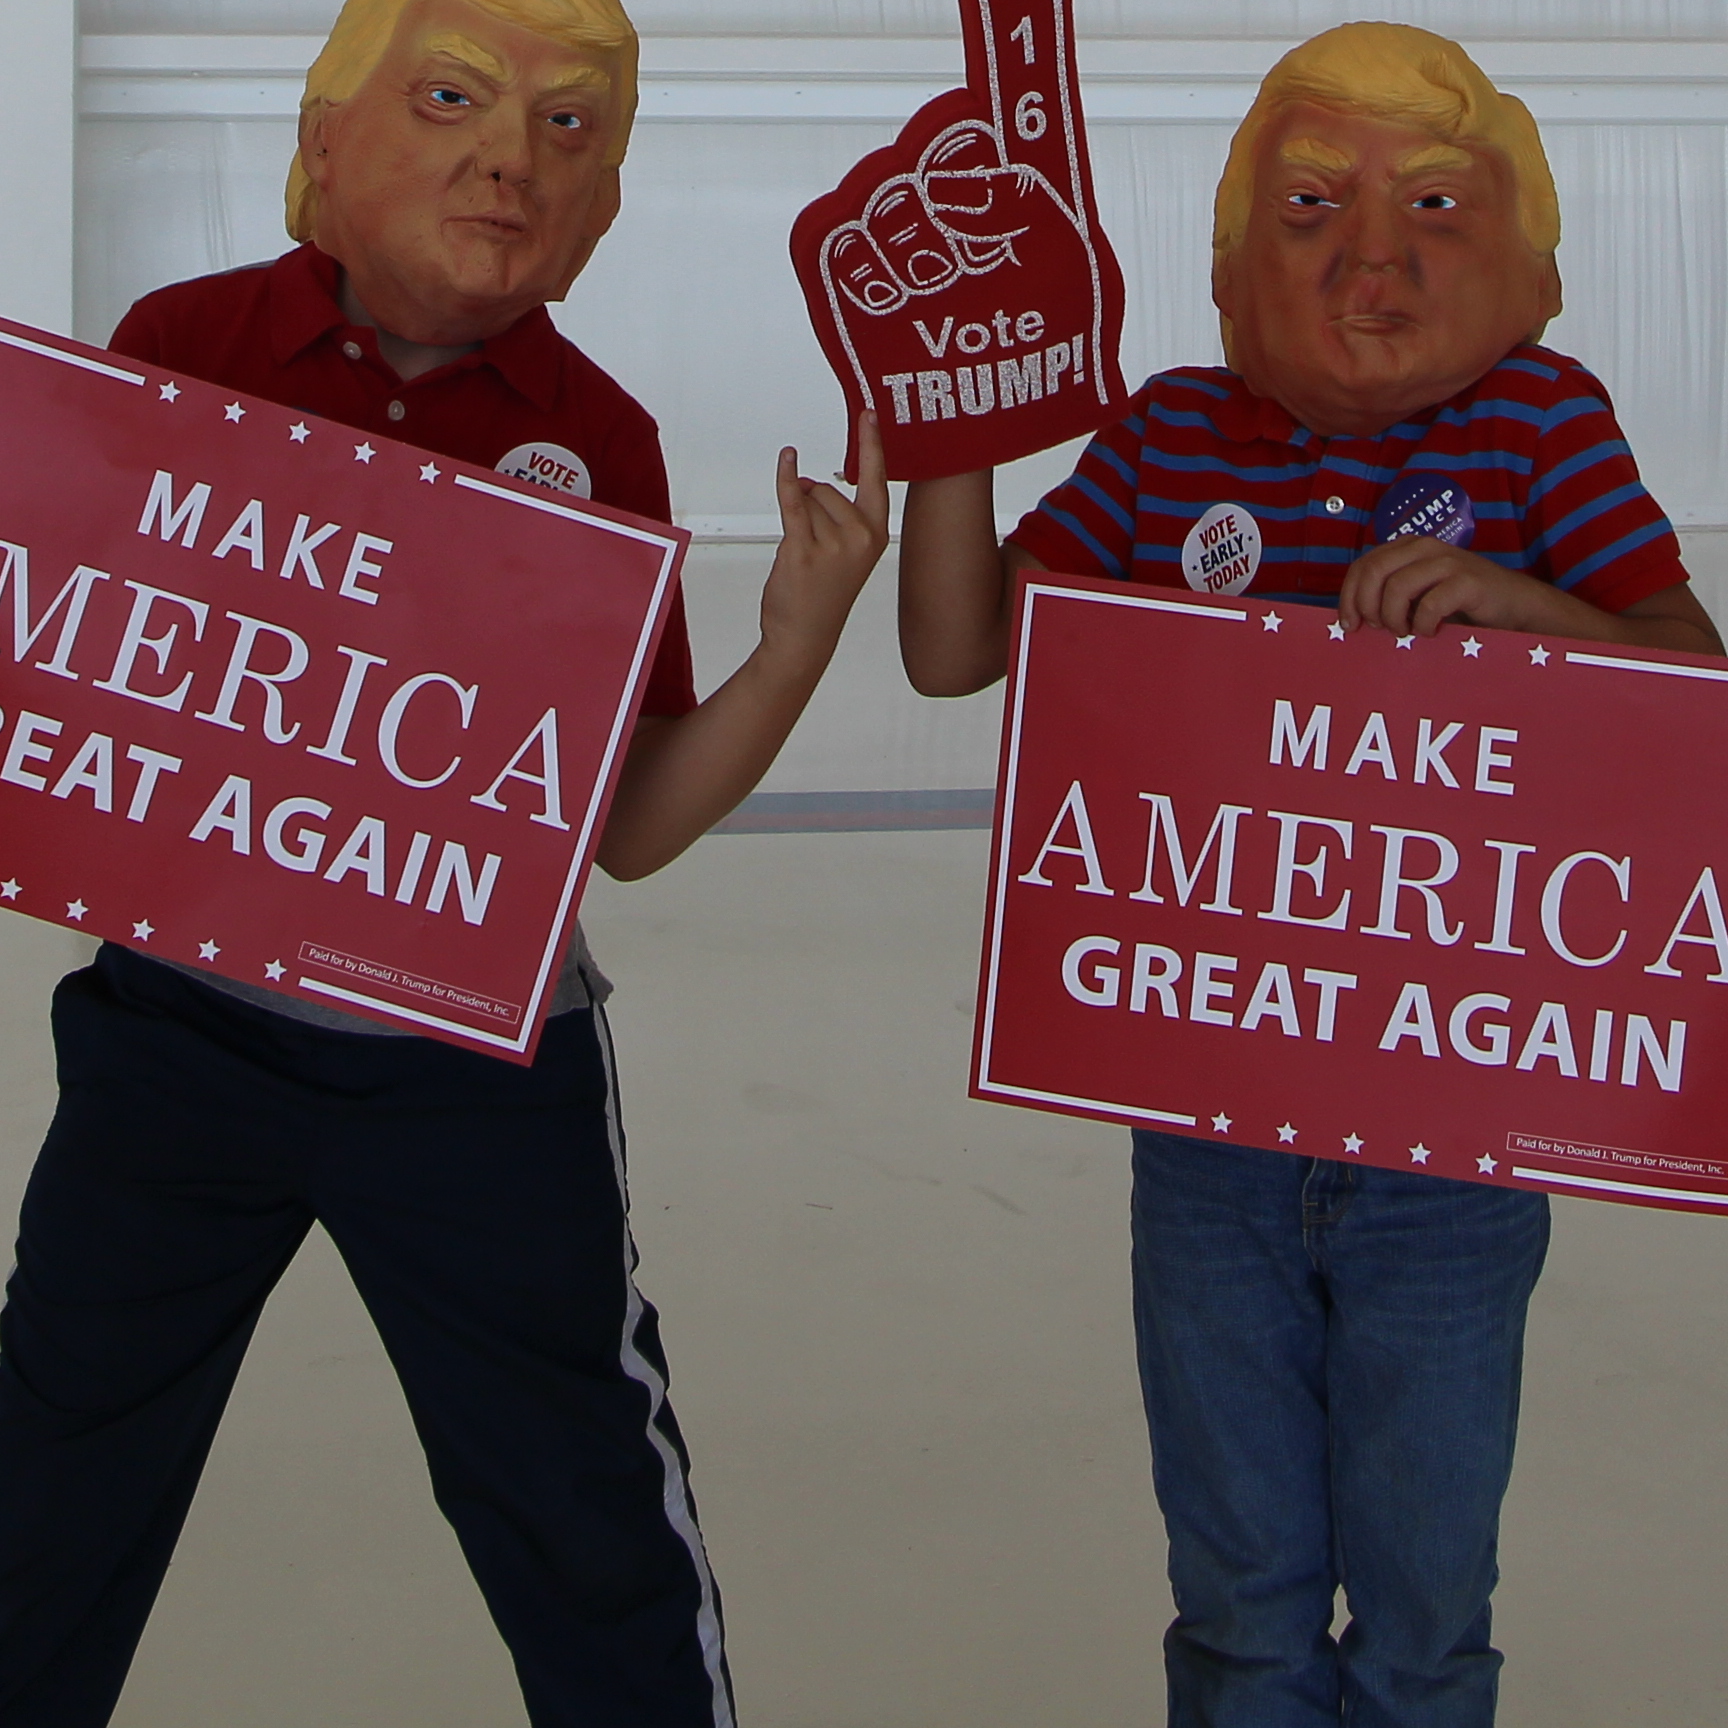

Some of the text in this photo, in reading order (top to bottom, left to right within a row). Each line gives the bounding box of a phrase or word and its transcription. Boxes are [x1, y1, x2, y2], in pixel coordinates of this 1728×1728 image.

[912, 308, 1045, 358] Vote
[882, 332, 1085, 424] TRUMP!
[527, 451, 580, 490] VOTE
[137, 469, 394, 606] MAKE
[1198, 513, 1238, 550] VOTE
[1436, 516, 1463, 539] MERICA
[1200, 532, 1244, 574] EARLY
[1203, 553, 1251, 593] TODAY
[1269, 699, 1519, 796] MAKE
[188, 774, 502, 926] AGAIN
[309, 947, 330, 962] Paid
[330, 953, 345, 966] for
[345, 958, 358, 972] by
[358, 962, 392, 980] Donald
[401, 975, 431, 994] Trump
[432, 984, 446, 996] for
[447, 989, 493, 1012] President,
[493, 1003, 510, 1017] Inc.
[1061, 935, 1687, 1093] GREAT AGAIN
[1516, 1137, 1537, 1149] Paid
[1538, 1140, 1553, 1151] for
[1553, 1142, 1565, 1155] by
[1566, 1145, 1601, 1159] Donald
[1611, 1151, 1642, 1166] Trump
[1643, 1155, 1658, 1166] for
[1659, 1158, 1706, 1174] President,
[1707, 1163, 1725, 1175] Inc.
